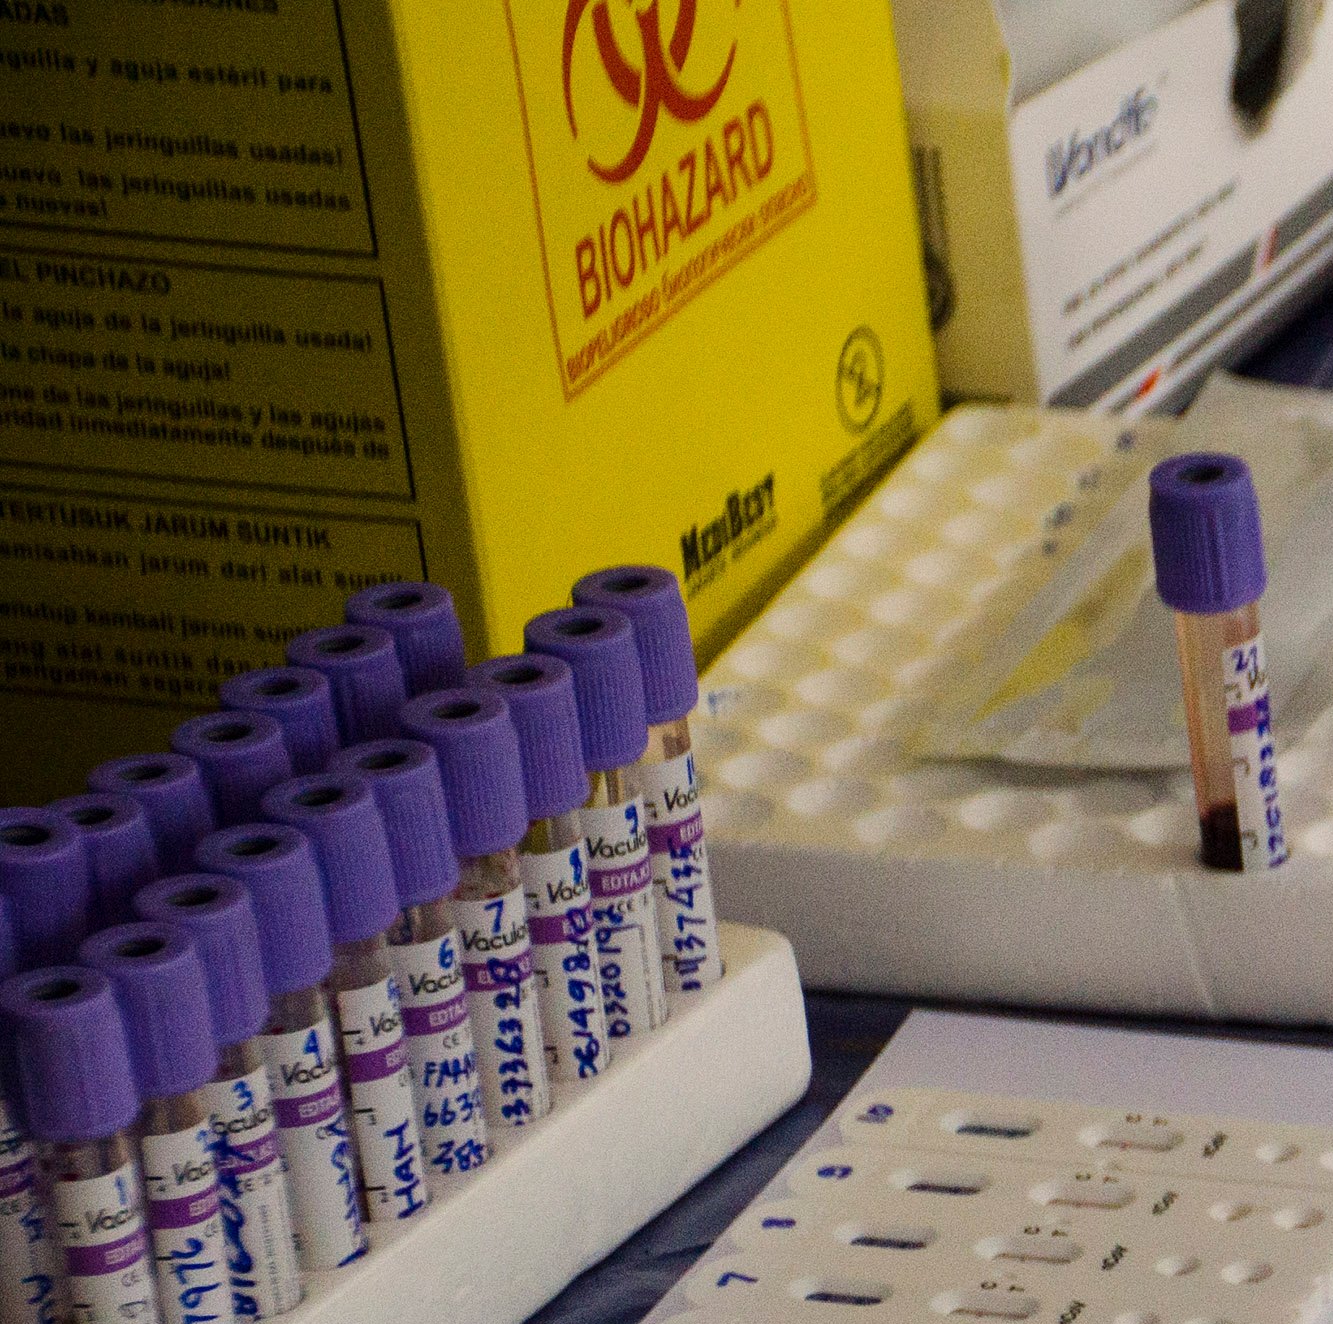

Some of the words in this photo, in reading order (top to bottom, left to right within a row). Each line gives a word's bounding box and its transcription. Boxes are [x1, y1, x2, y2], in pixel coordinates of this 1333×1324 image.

[111, 58, 178, 82] aguja
[278, 73, 333, 95] para
[574, 99, 775, 321] BIOHAZARD
[36, 262, 172, 296] PINCHAZO
[141, 512, 230, 540] JARUM
[237, 521, 333, 551] SUNTIK
[140, 552, 209, 578] jarum
[483, 899, 505, 935] 7
[438, 938, 455, 969] 6
[302, 1029, 321, 1065] 4
[231, 1080, 254, 1113] 3
[114, 1175, 127, 1206] 1
[717, 1272, 756, 1287] 7
